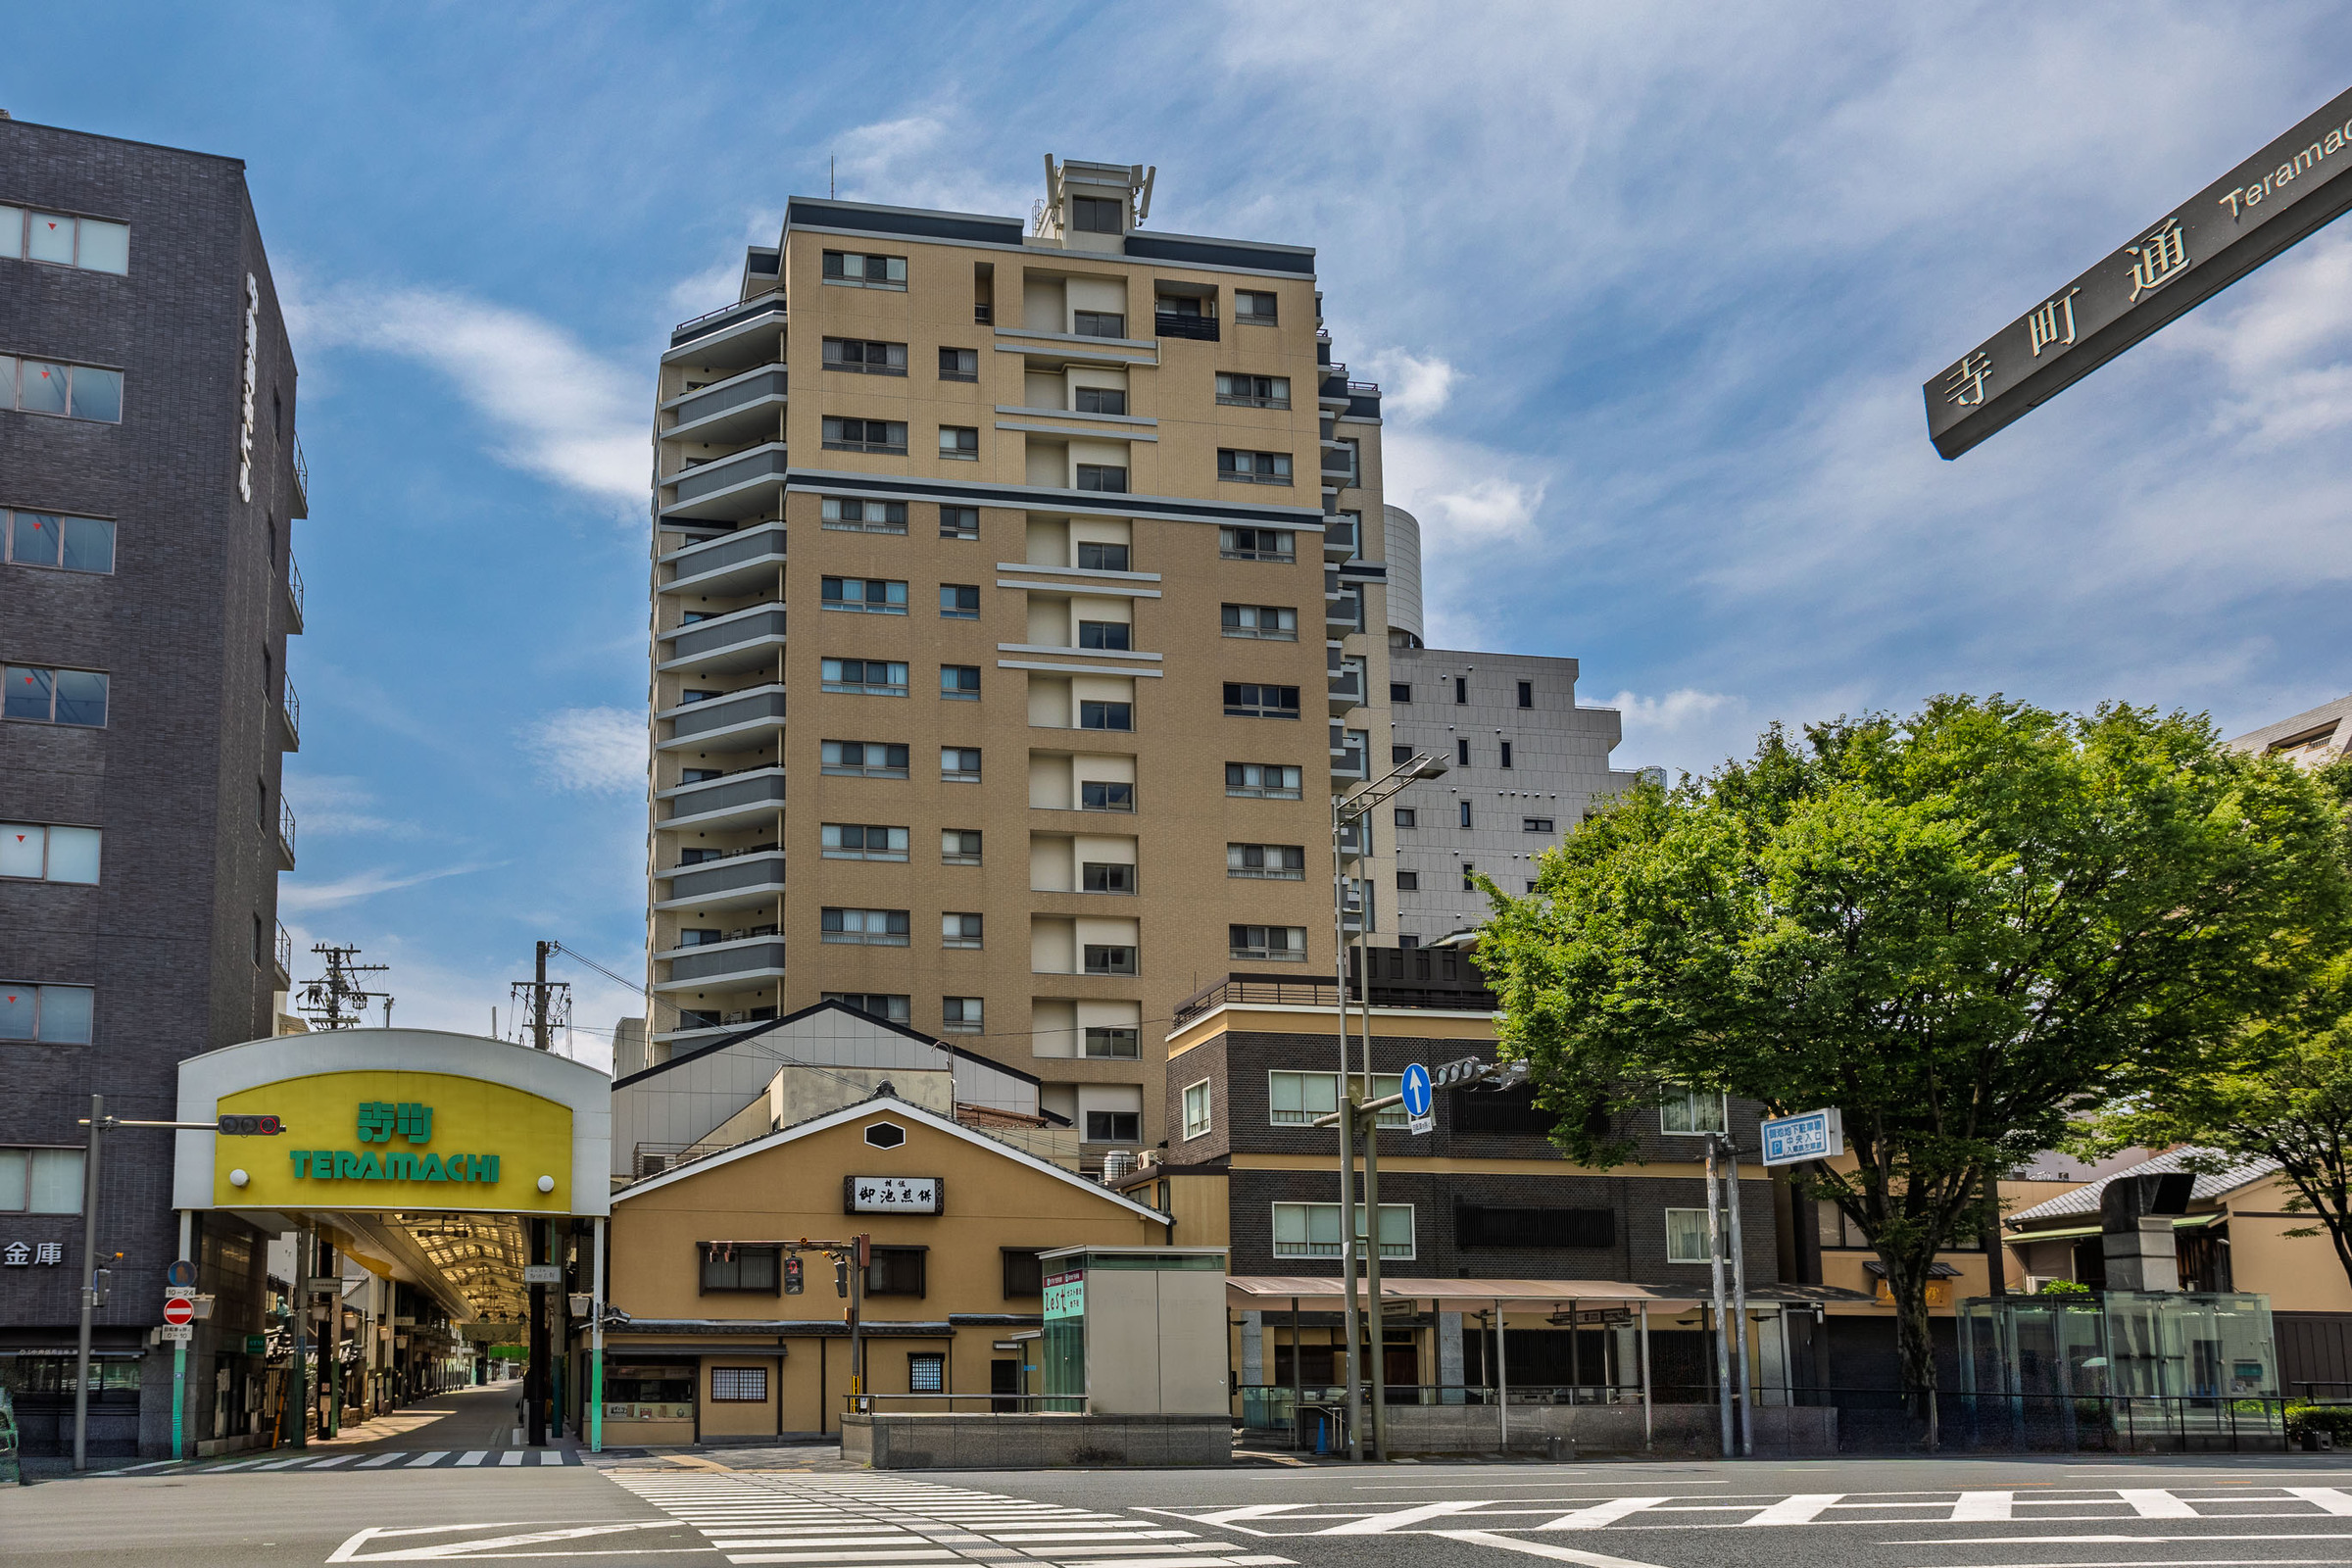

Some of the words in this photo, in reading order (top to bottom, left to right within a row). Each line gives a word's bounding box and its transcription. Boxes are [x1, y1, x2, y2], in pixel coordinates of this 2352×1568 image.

[1944, 218, 2191, 407] 寺町通
[358, 1102, 434, 1145] 寺町
[1787, 1132, 1821, 1145] 中央入口
[289, 1150, 500, 1183] TERAMACHI
[3, 1241, 64, 1266] 金庫
[1046, 1289, 1066, 1312] Zest
